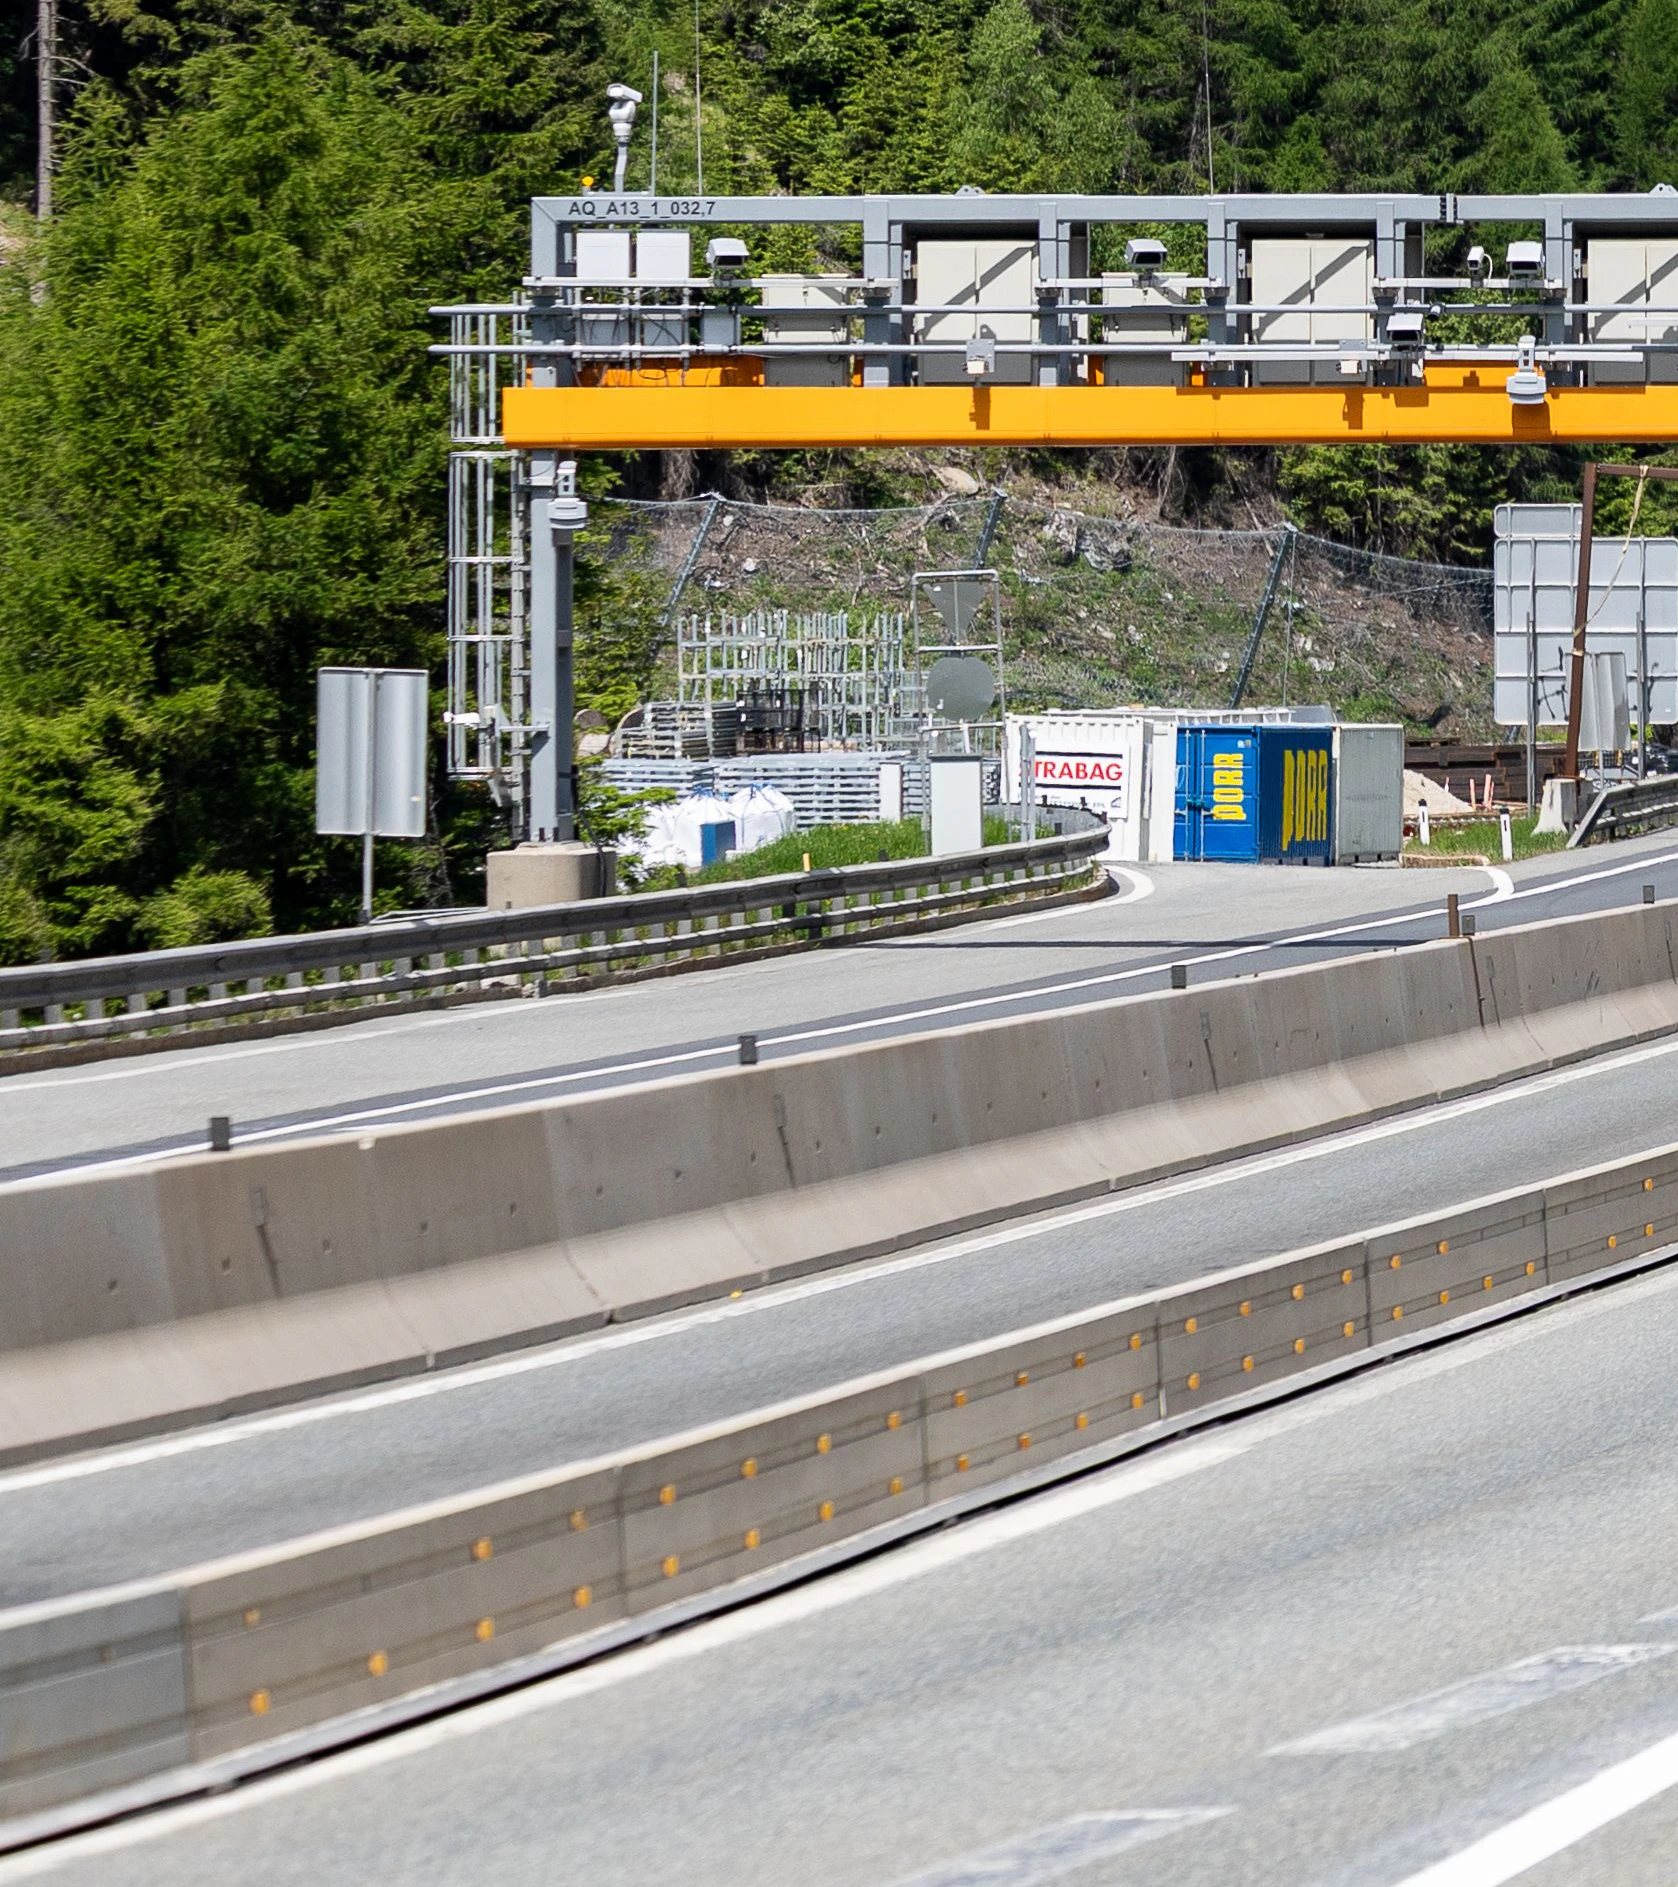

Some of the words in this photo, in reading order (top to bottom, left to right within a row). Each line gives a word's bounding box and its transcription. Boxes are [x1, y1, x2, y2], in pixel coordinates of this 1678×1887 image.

[568, 201, 716, 219] AQ_A13_1_032,7
[1019, 761, 1123, 781] TRABAG
[1213, 753, 1246, 820] PORR
[1281, 749, 1328, 851] PORR
